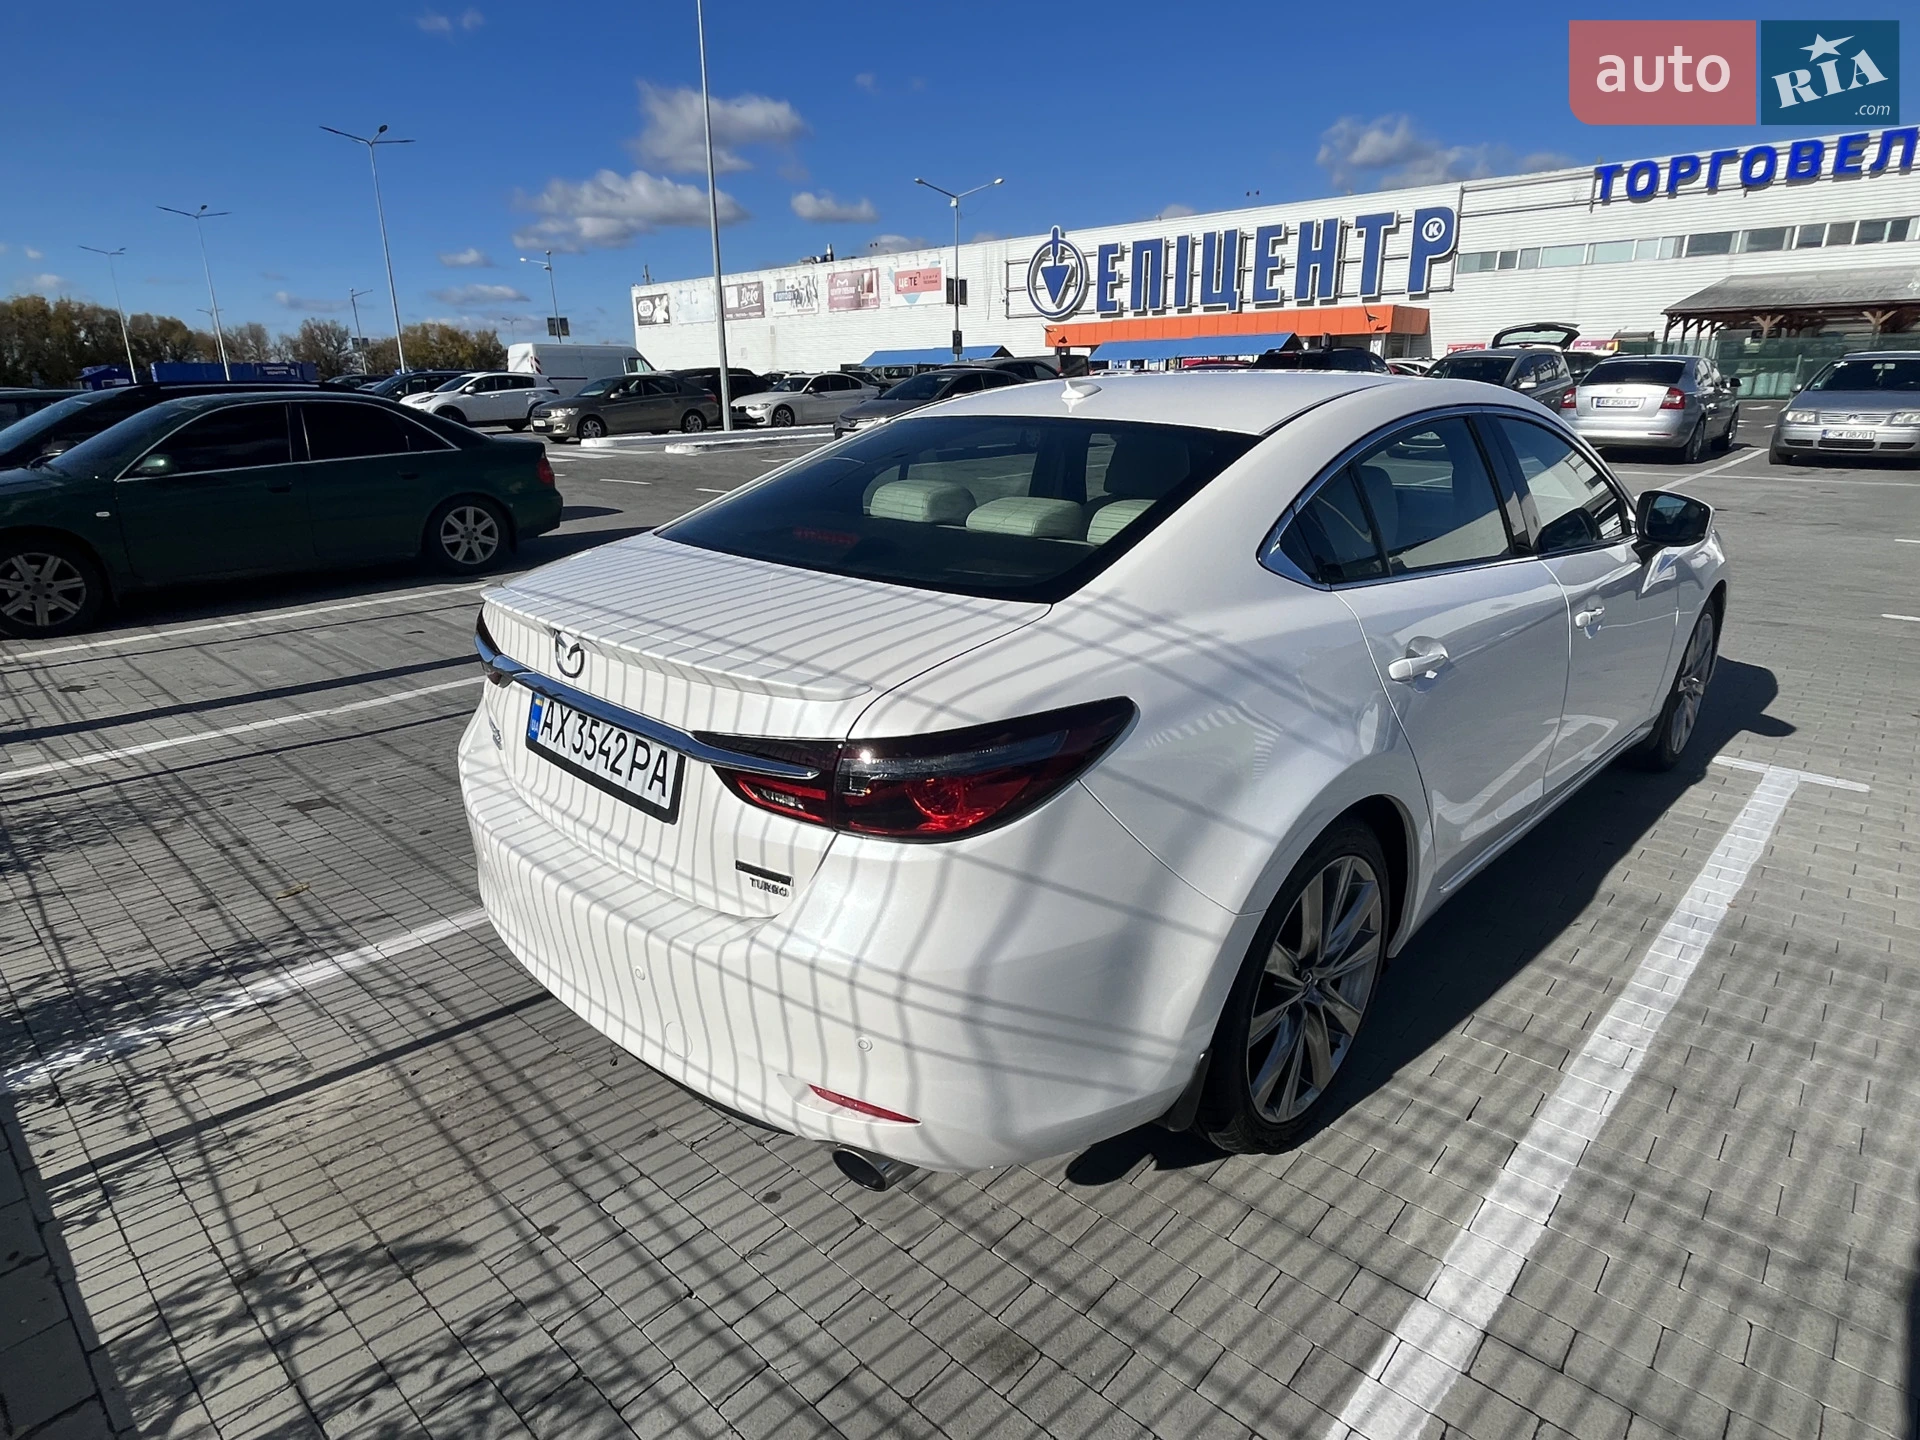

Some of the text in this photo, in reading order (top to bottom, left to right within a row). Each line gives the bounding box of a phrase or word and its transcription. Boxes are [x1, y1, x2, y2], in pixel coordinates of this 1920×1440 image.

[1594, 127, 1920, 204] ТОРГОВЕЛ
[1095, 205, 1460, 316] ЕПІЦЕНТР
[540, 700, 573, 748] AX
[571, 713, 627, 777] 3542
[627, 738, 668, 798] PA
[749, 876, 789, 898] TURBO
